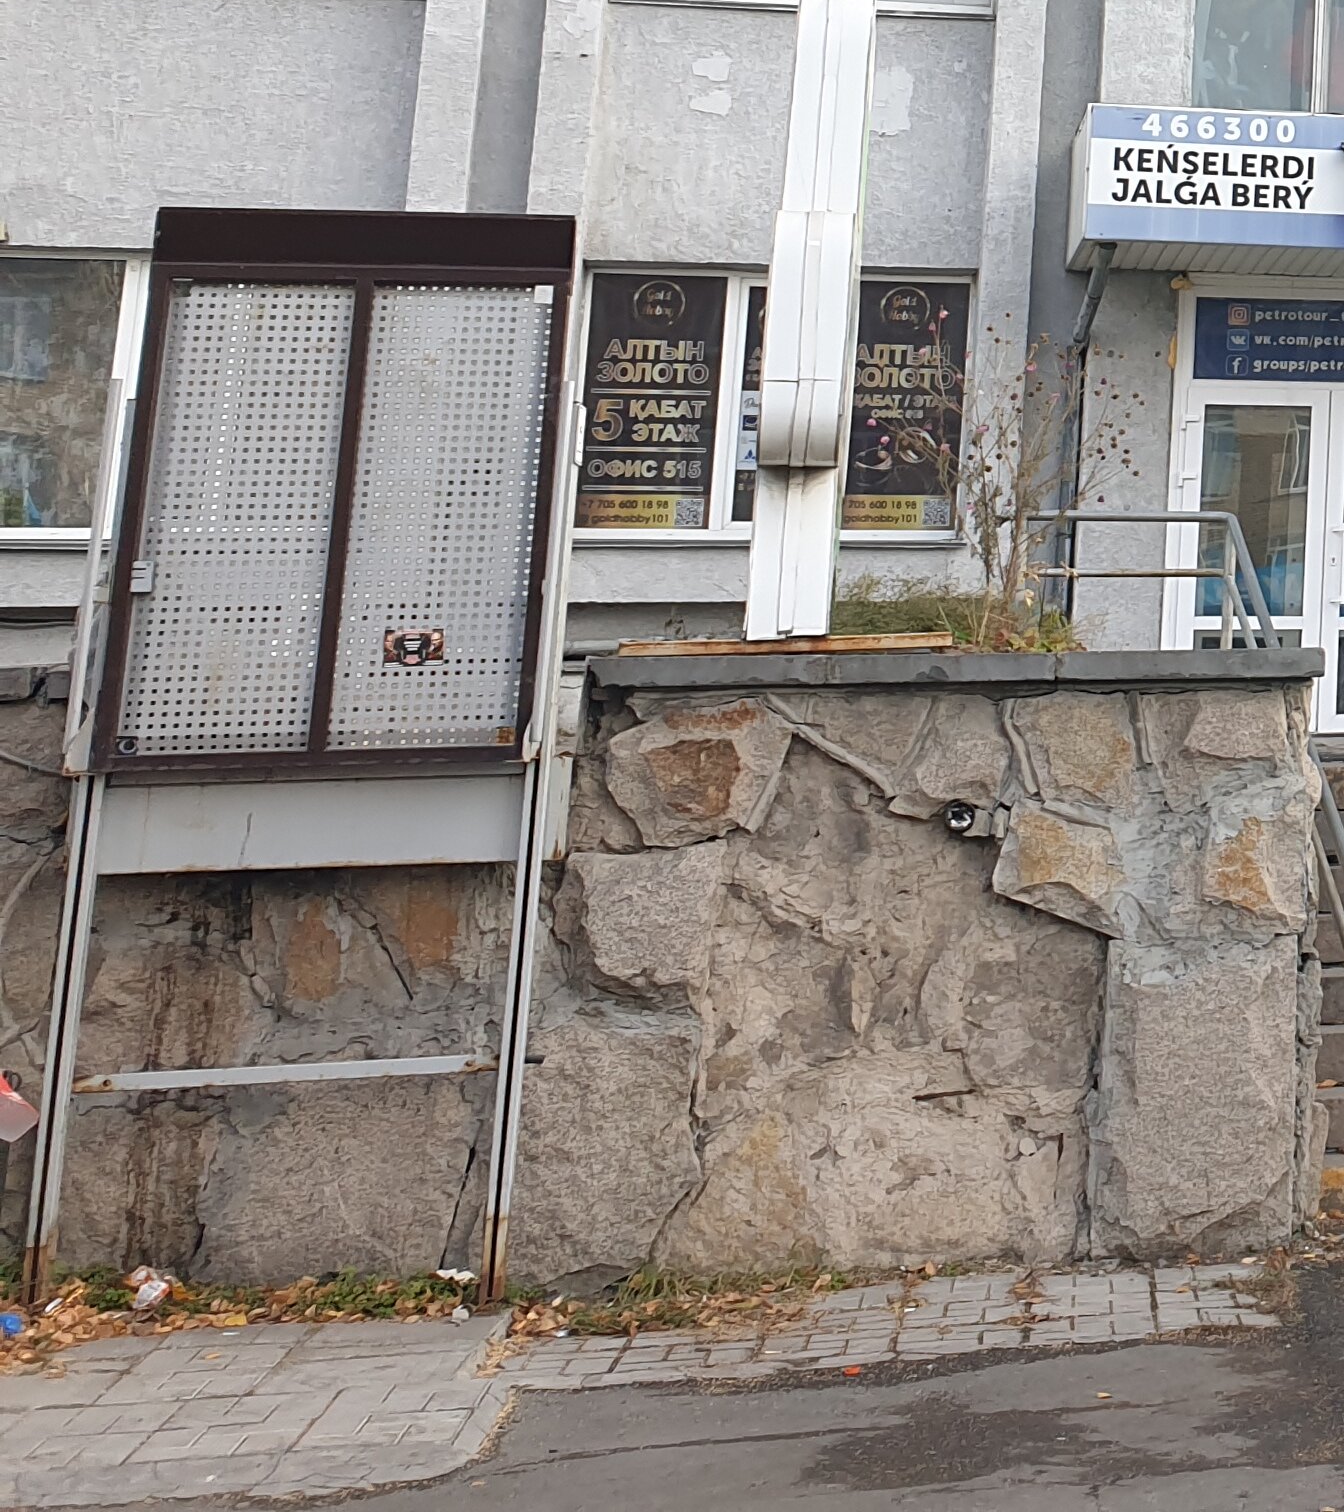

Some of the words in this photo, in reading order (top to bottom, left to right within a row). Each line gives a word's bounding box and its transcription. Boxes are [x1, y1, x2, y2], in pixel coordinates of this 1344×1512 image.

[1142, 113, 1296, 143] 466300
[1231, 180, 1315, 210] BERÝ
[603, 338, 705, 361] АЛТЫН
[596, 361, 710, 384] ЗОЛОТО
[591, 399, 624, 441] 5
[629, 399, 707, 421] ҚАБАТ
[631, 423, 700, 442] ЭТАЖ
[587, 459, 658, 478] ОФИС
[662, 460, 702, 478] 515
[597, 500, 615, 509] 705
[618, 500, 638, 509] 600
[642, 500, 653, 509] 18
[656, 500, 669, 509] 98
